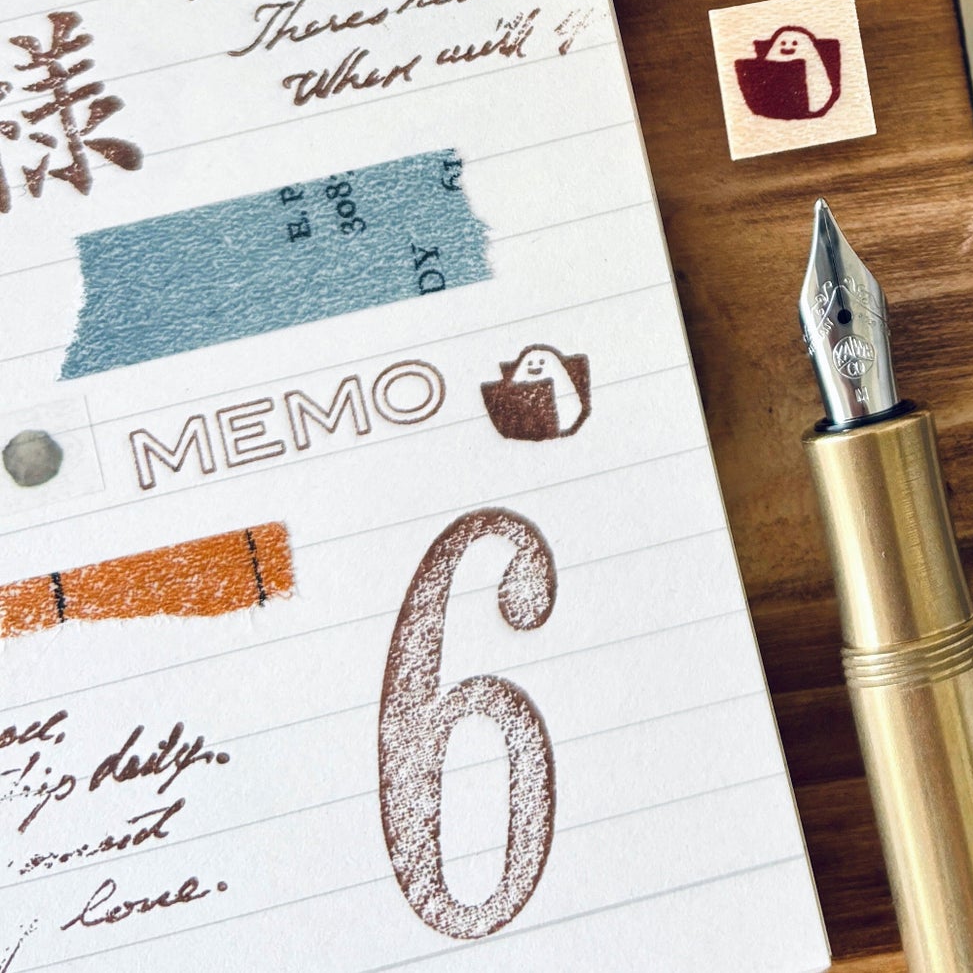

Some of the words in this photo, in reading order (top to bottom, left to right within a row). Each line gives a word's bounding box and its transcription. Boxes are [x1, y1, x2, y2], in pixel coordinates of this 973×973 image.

[283, 47, 422, 106] When
[129, 359, 447, 491] MEMO
[378, 506, 559, 941] 6
[60, 876, 229, 931] love.
